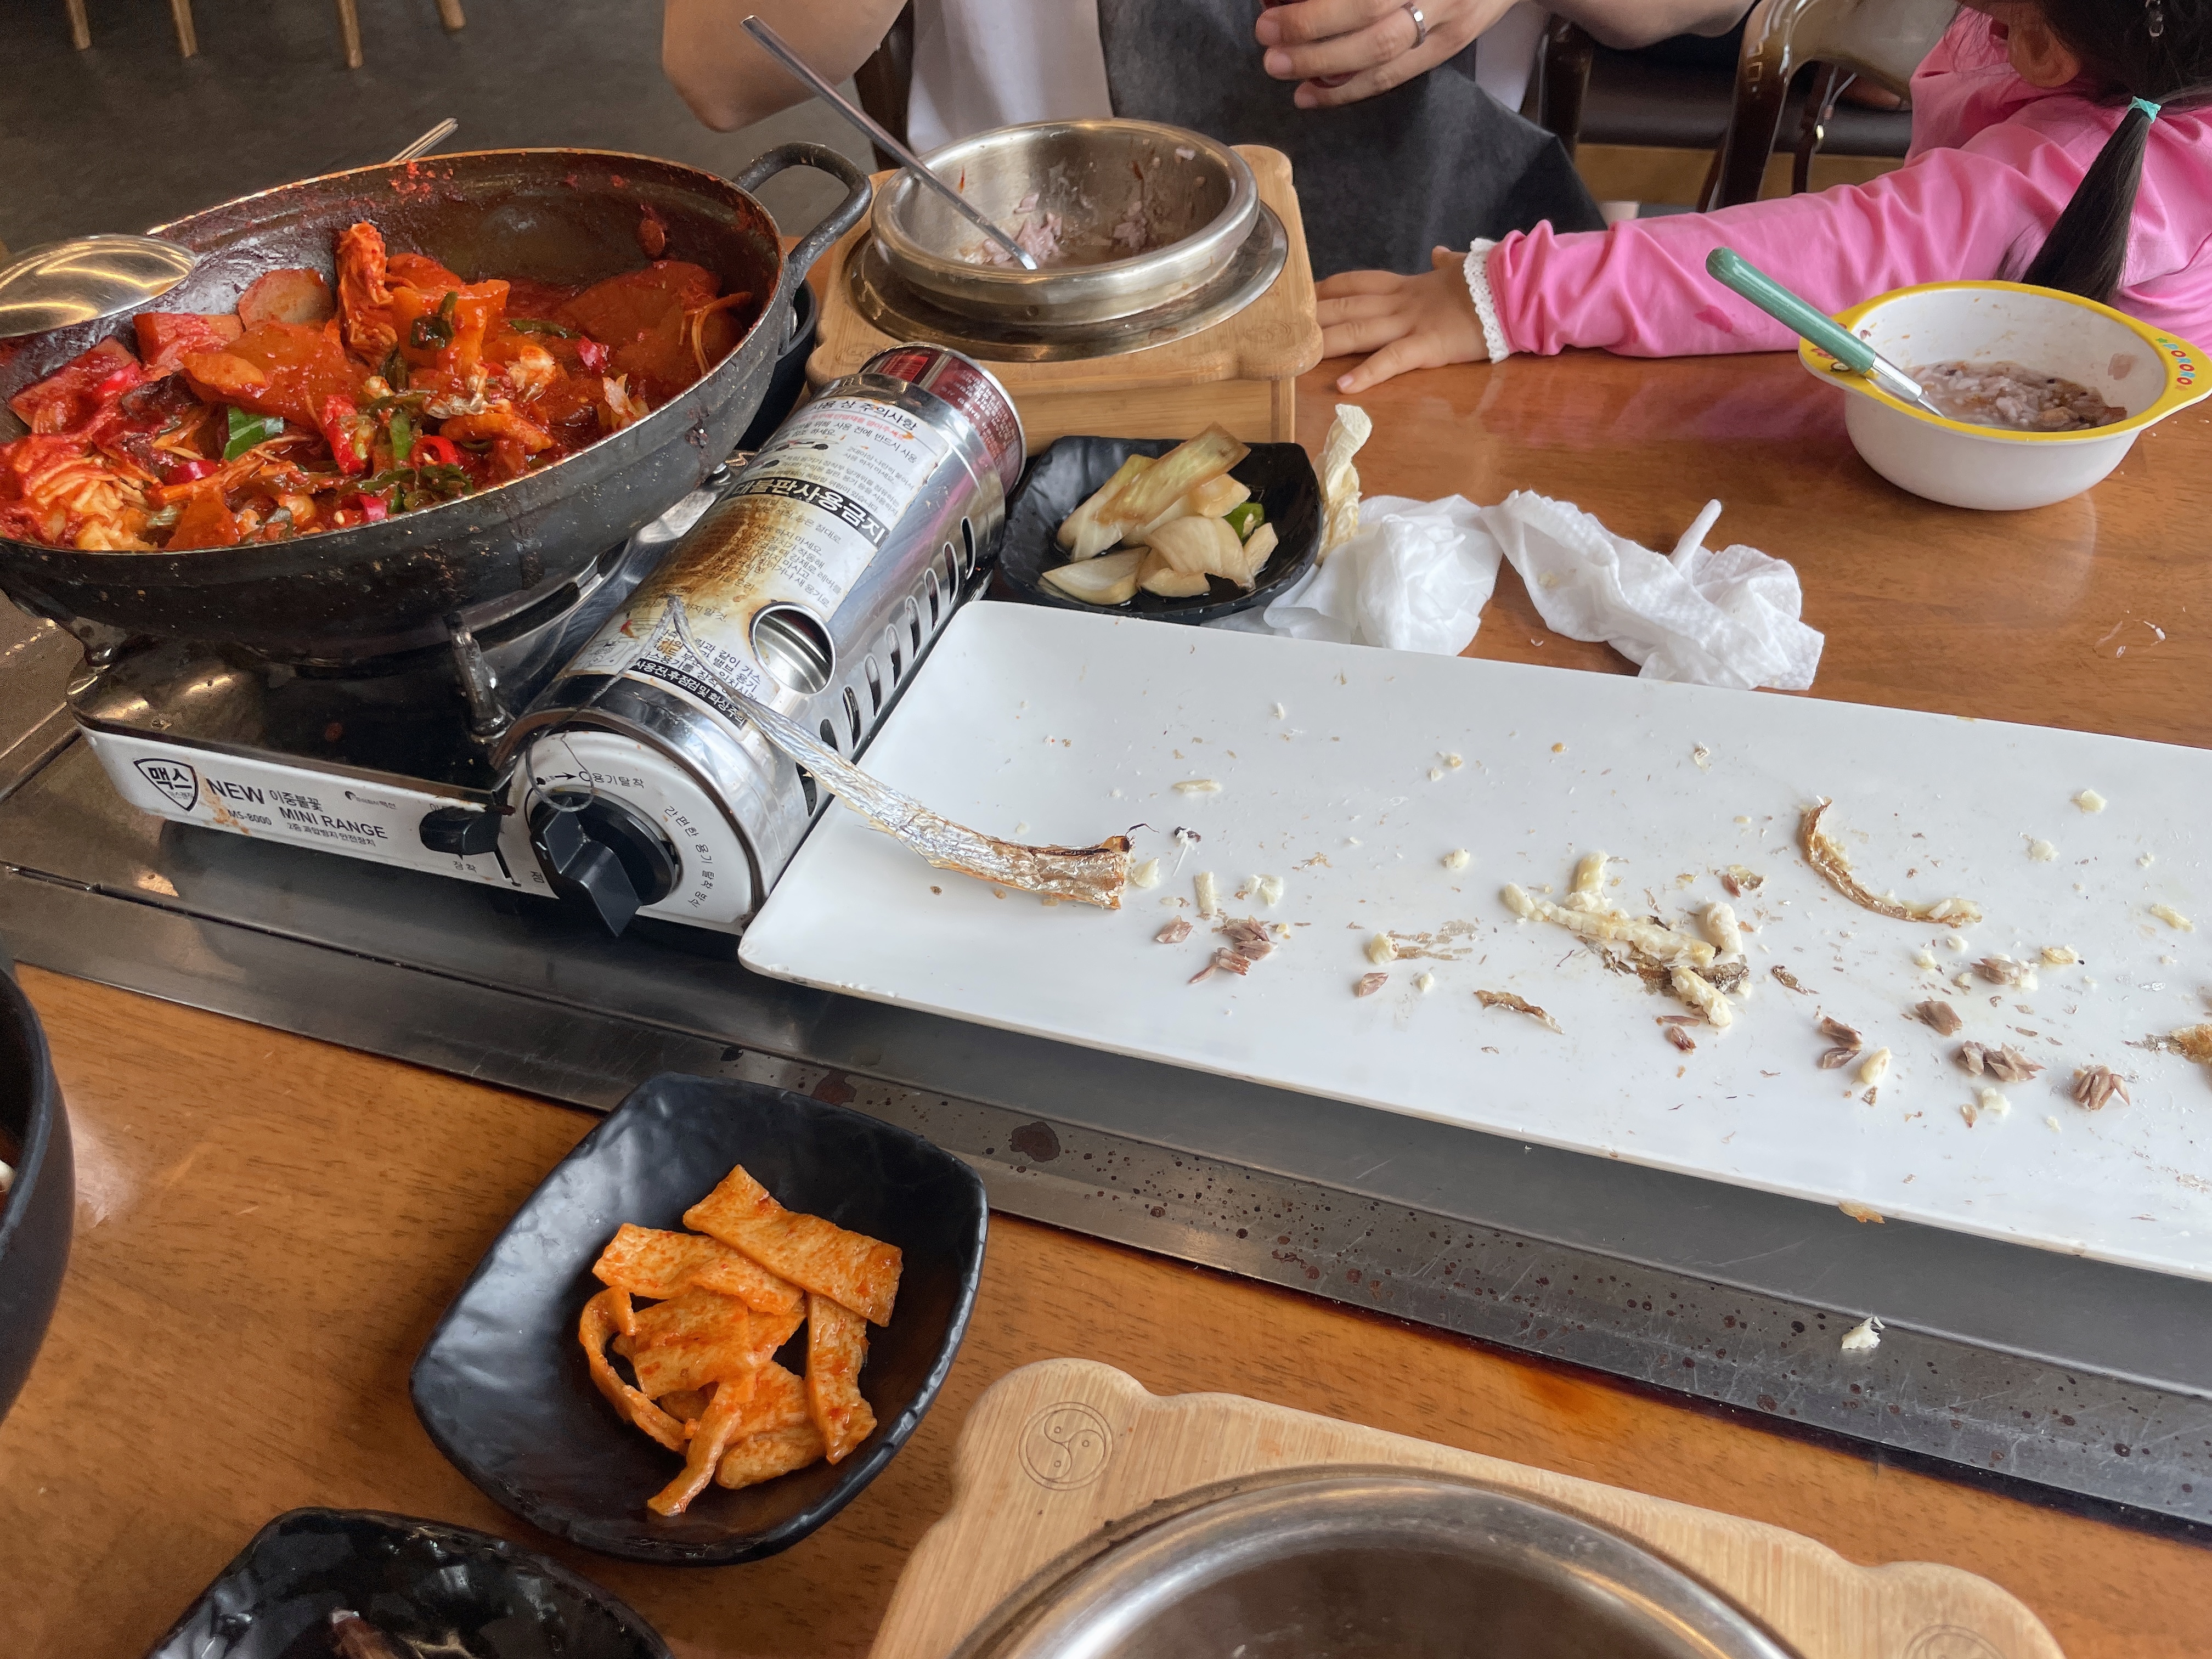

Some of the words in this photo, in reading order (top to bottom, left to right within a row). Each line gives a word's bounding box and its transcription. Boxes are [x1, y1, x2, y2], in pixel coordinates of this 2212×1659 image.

[860, 403, 917, 431] 주의사항
[834, 421, 853, 431] 사용
[854, 426, 872, 437] 전에
[874, 433, 901, 452] 반드시
[901, 448, 918, 464] 사용
[775, 528, 794, 539] 하지
[815, 524, 842, 544] 절대로
[783, 558, 810, 580] 마시고
[798, 548, 825, 569] 작동해
[789, 554, 816, 574] 강제로
[817, 572, 842, 595] 레버를
[794, 577, 805, 587] 새
[805, 584, 830, 608] 용기로
[719, 650, 741, 668] 같이
[742, 665, 761, 685] 가스
[737, 674, 758, 692] 용기
[148, 767, 193, 789] 맥스
[592, 772, 645, 788] 용기탈착
[206, 778, 264, 804] NEW
[269, 789, 323, 812] 이중불꽃
[279, 806, 318, 825] MINI
[321, 815, 388, 839] RANGE
[663, 805, 700, 838] 간편한
[695, 843, 715, 865] 용기
[688, 891, 708, 909] 방식
